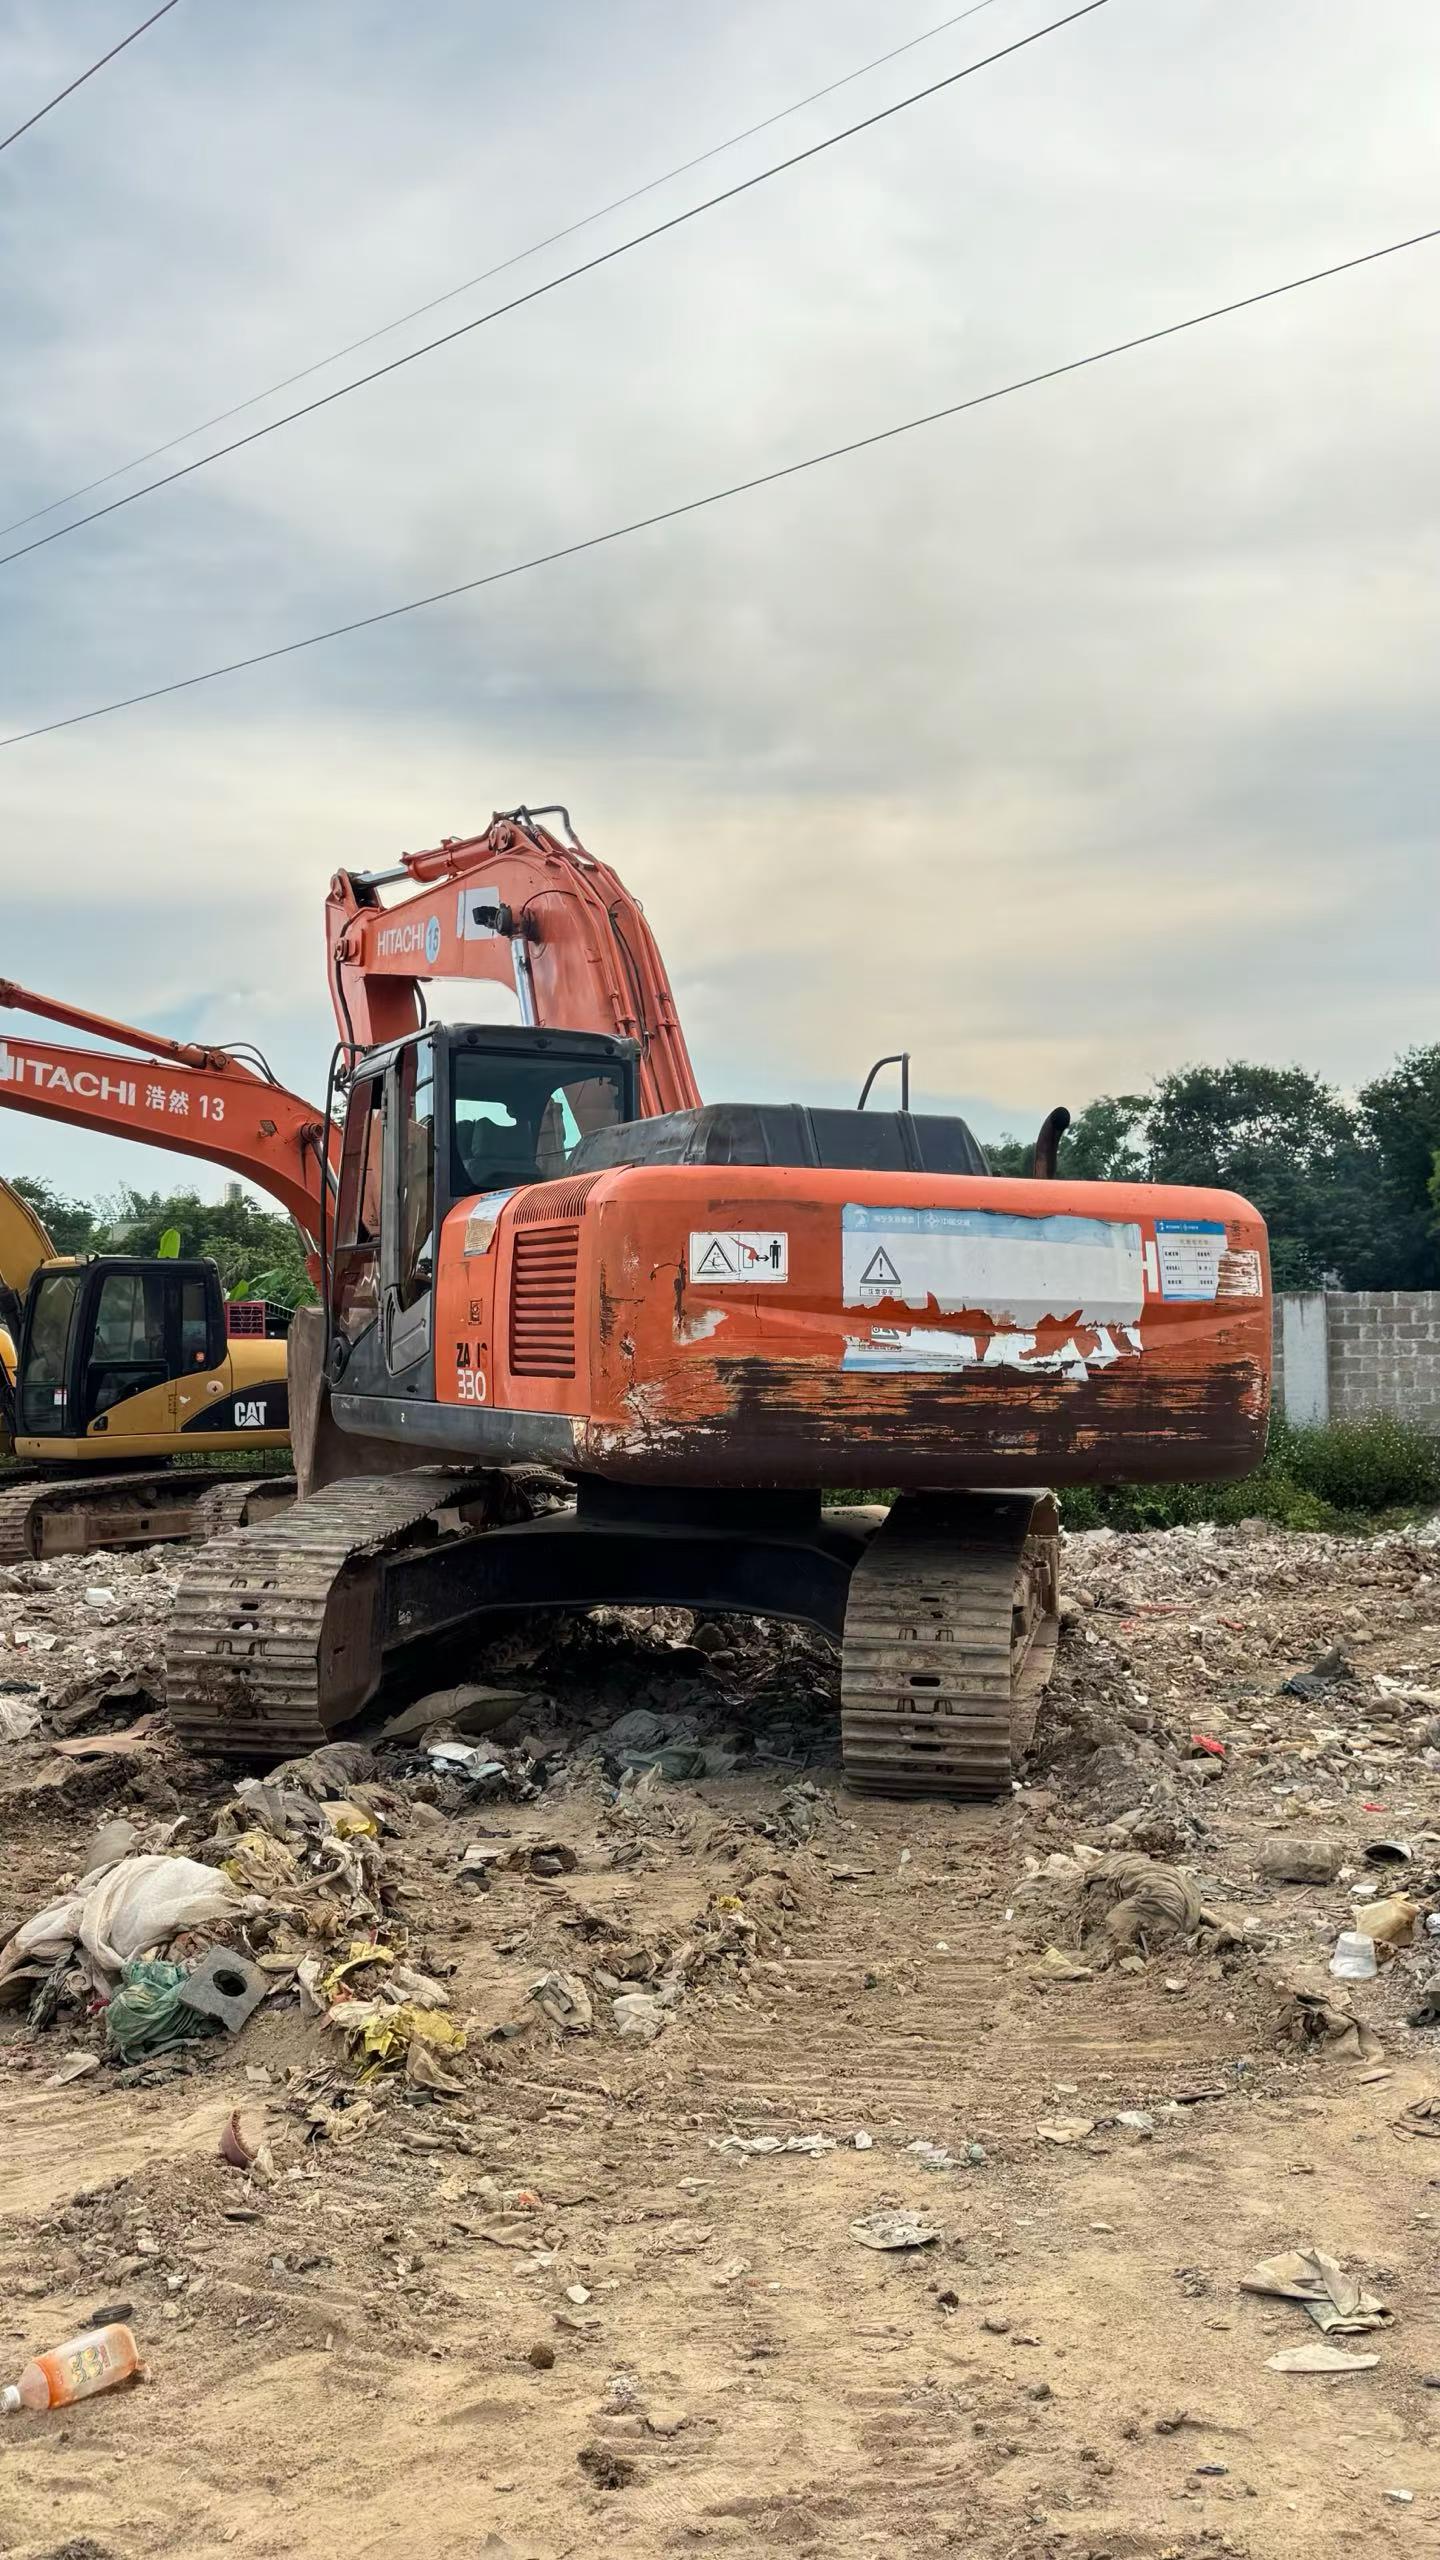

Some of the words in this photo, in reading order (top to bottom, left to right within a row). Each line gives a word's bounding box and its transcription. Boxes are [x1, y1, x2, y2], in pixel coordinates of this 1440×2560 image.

[377, 922, 424, 956] HITACHI
[145, 1083, 189, 1116] 浩然
[199, 1095, 225, 1122] 13
[457, 1369, 486, 1401] 330
[234, 1401, 267, 1427] CAT
